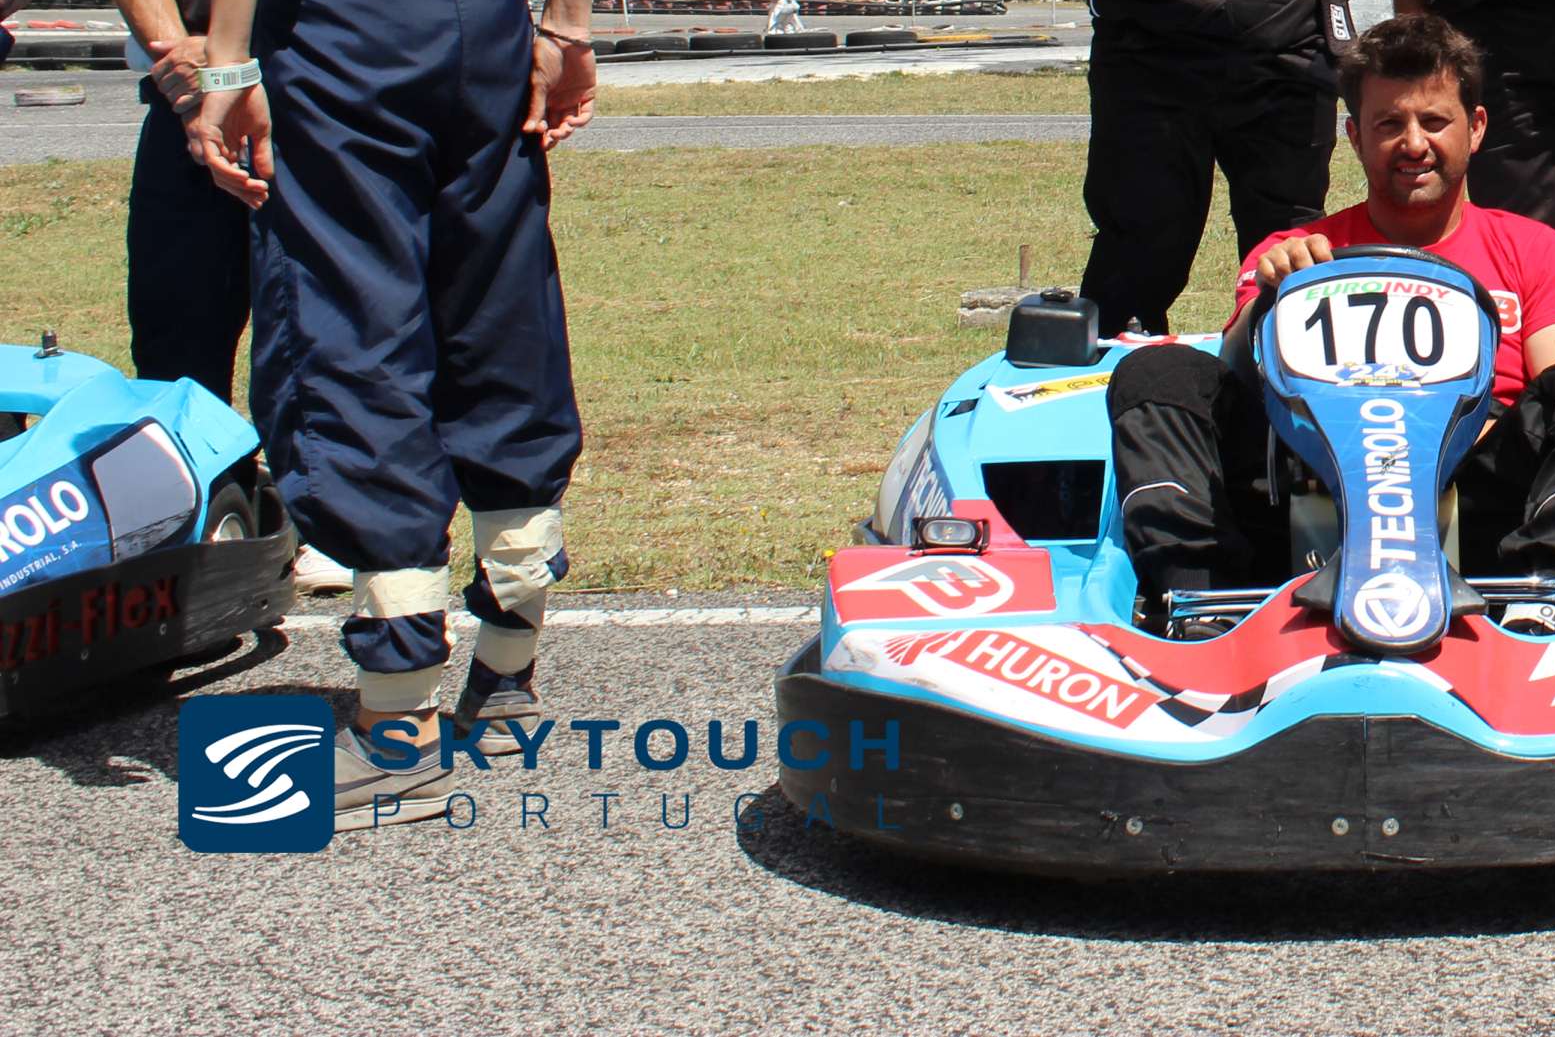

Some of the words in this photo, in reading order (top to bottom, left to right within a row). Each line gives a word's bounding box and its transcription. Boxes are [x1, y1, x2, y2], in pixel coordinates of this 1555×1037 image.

[1304, 280, 1451, 302] EUROINDY
[1304, 291, 1445, 367] 170
[1359, 397, 1418, 571] TECNIROLO
[964, 633, 1140, 720] HURON
